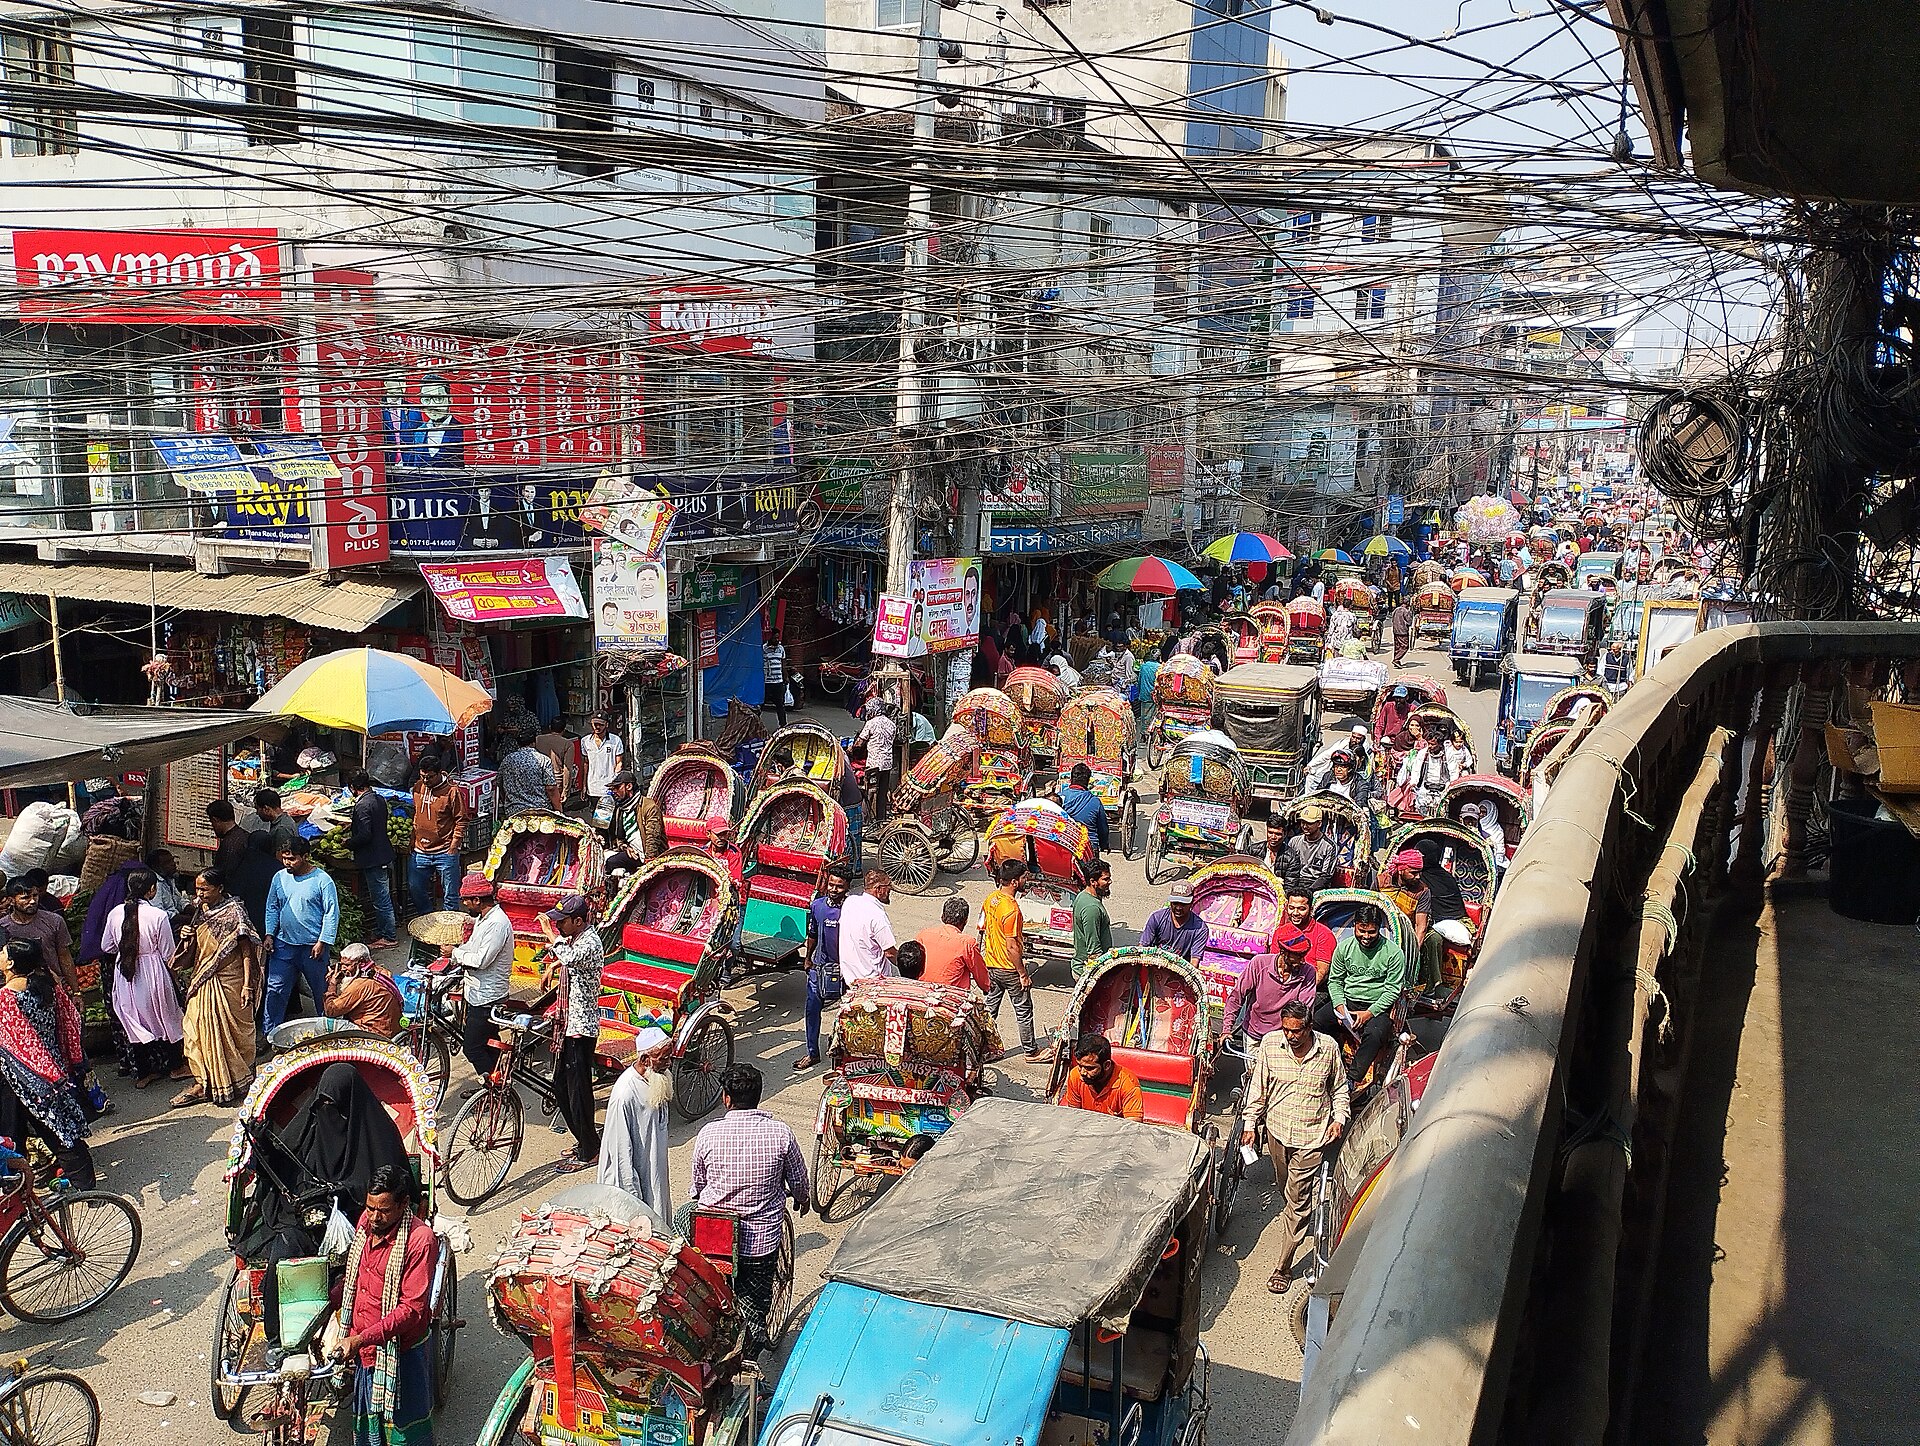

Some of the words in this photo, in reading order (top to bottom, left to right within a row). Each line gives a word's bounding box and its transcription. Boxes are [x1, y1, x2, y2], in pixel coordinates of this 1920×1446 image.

[390, 495, 459, 519] PLUS
[674, 494, 707, 515] PLUS
[344, 539, 380, 553] PLUS
[623, 609, 658, 621] শুভেচ্ছা
[887, 614, 905, 626] বিল
[629, 622, 661, 633] স্বাগতম
[880, 621, 907, 634] বিকাশ
[882, 632, 903, 642] করুন
